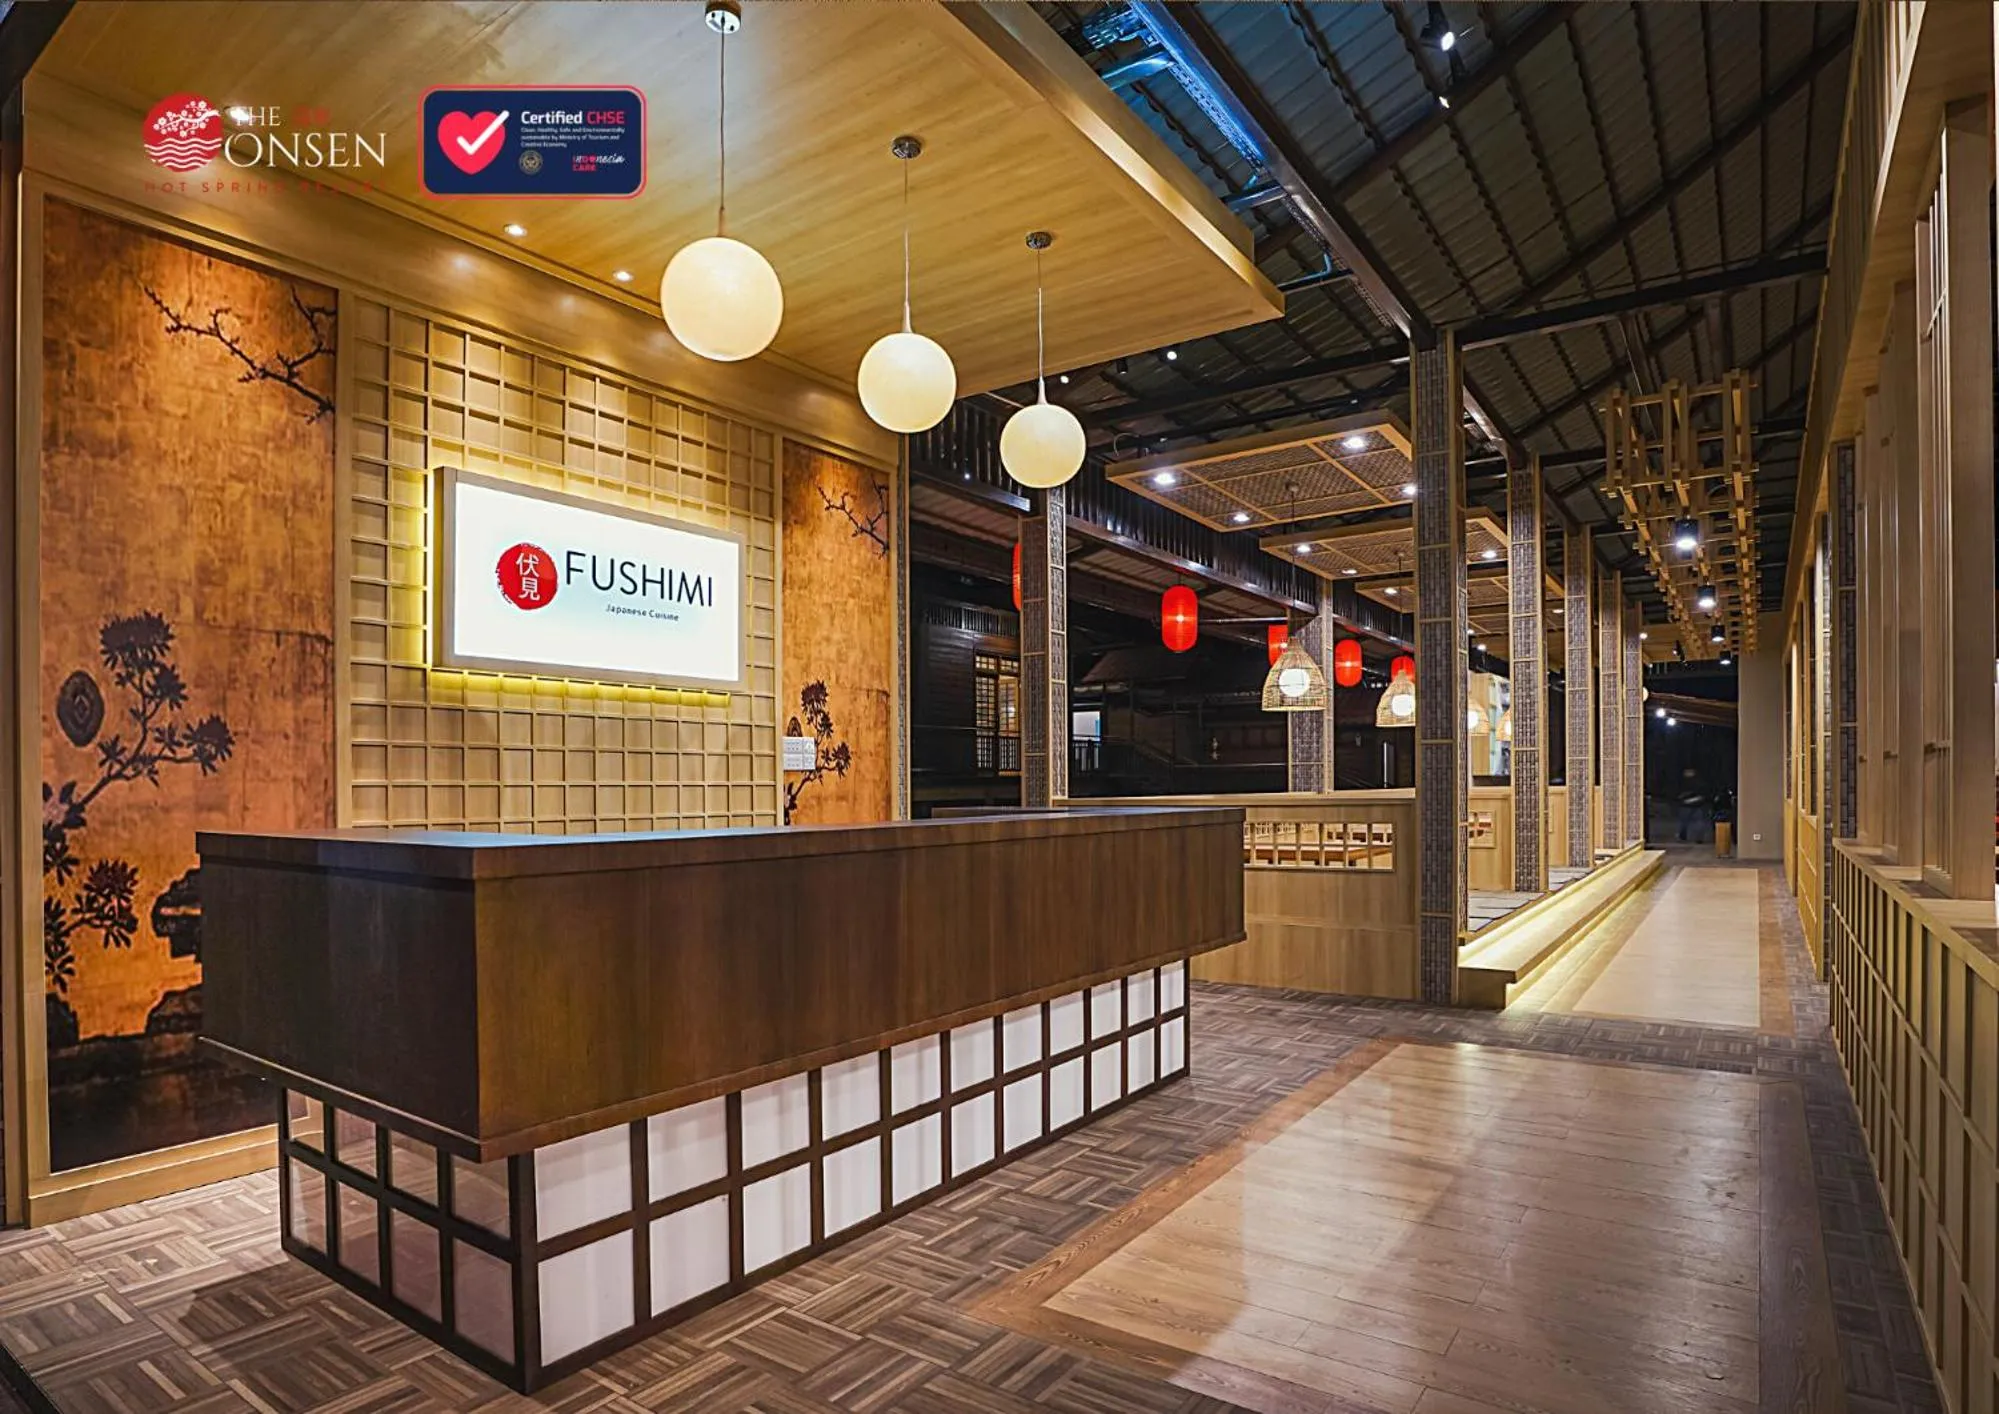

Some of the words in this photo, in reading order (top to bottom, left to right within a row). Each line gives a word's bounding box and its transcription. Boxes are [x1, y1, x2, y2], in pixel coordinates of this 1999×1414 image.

[515, 552, 541, 601] 伏見
[565, 550, 713, 607] FUSHIMI
[605, 603, 647, 617] Japanese
[648, 608, 680, 622] Cuisine
